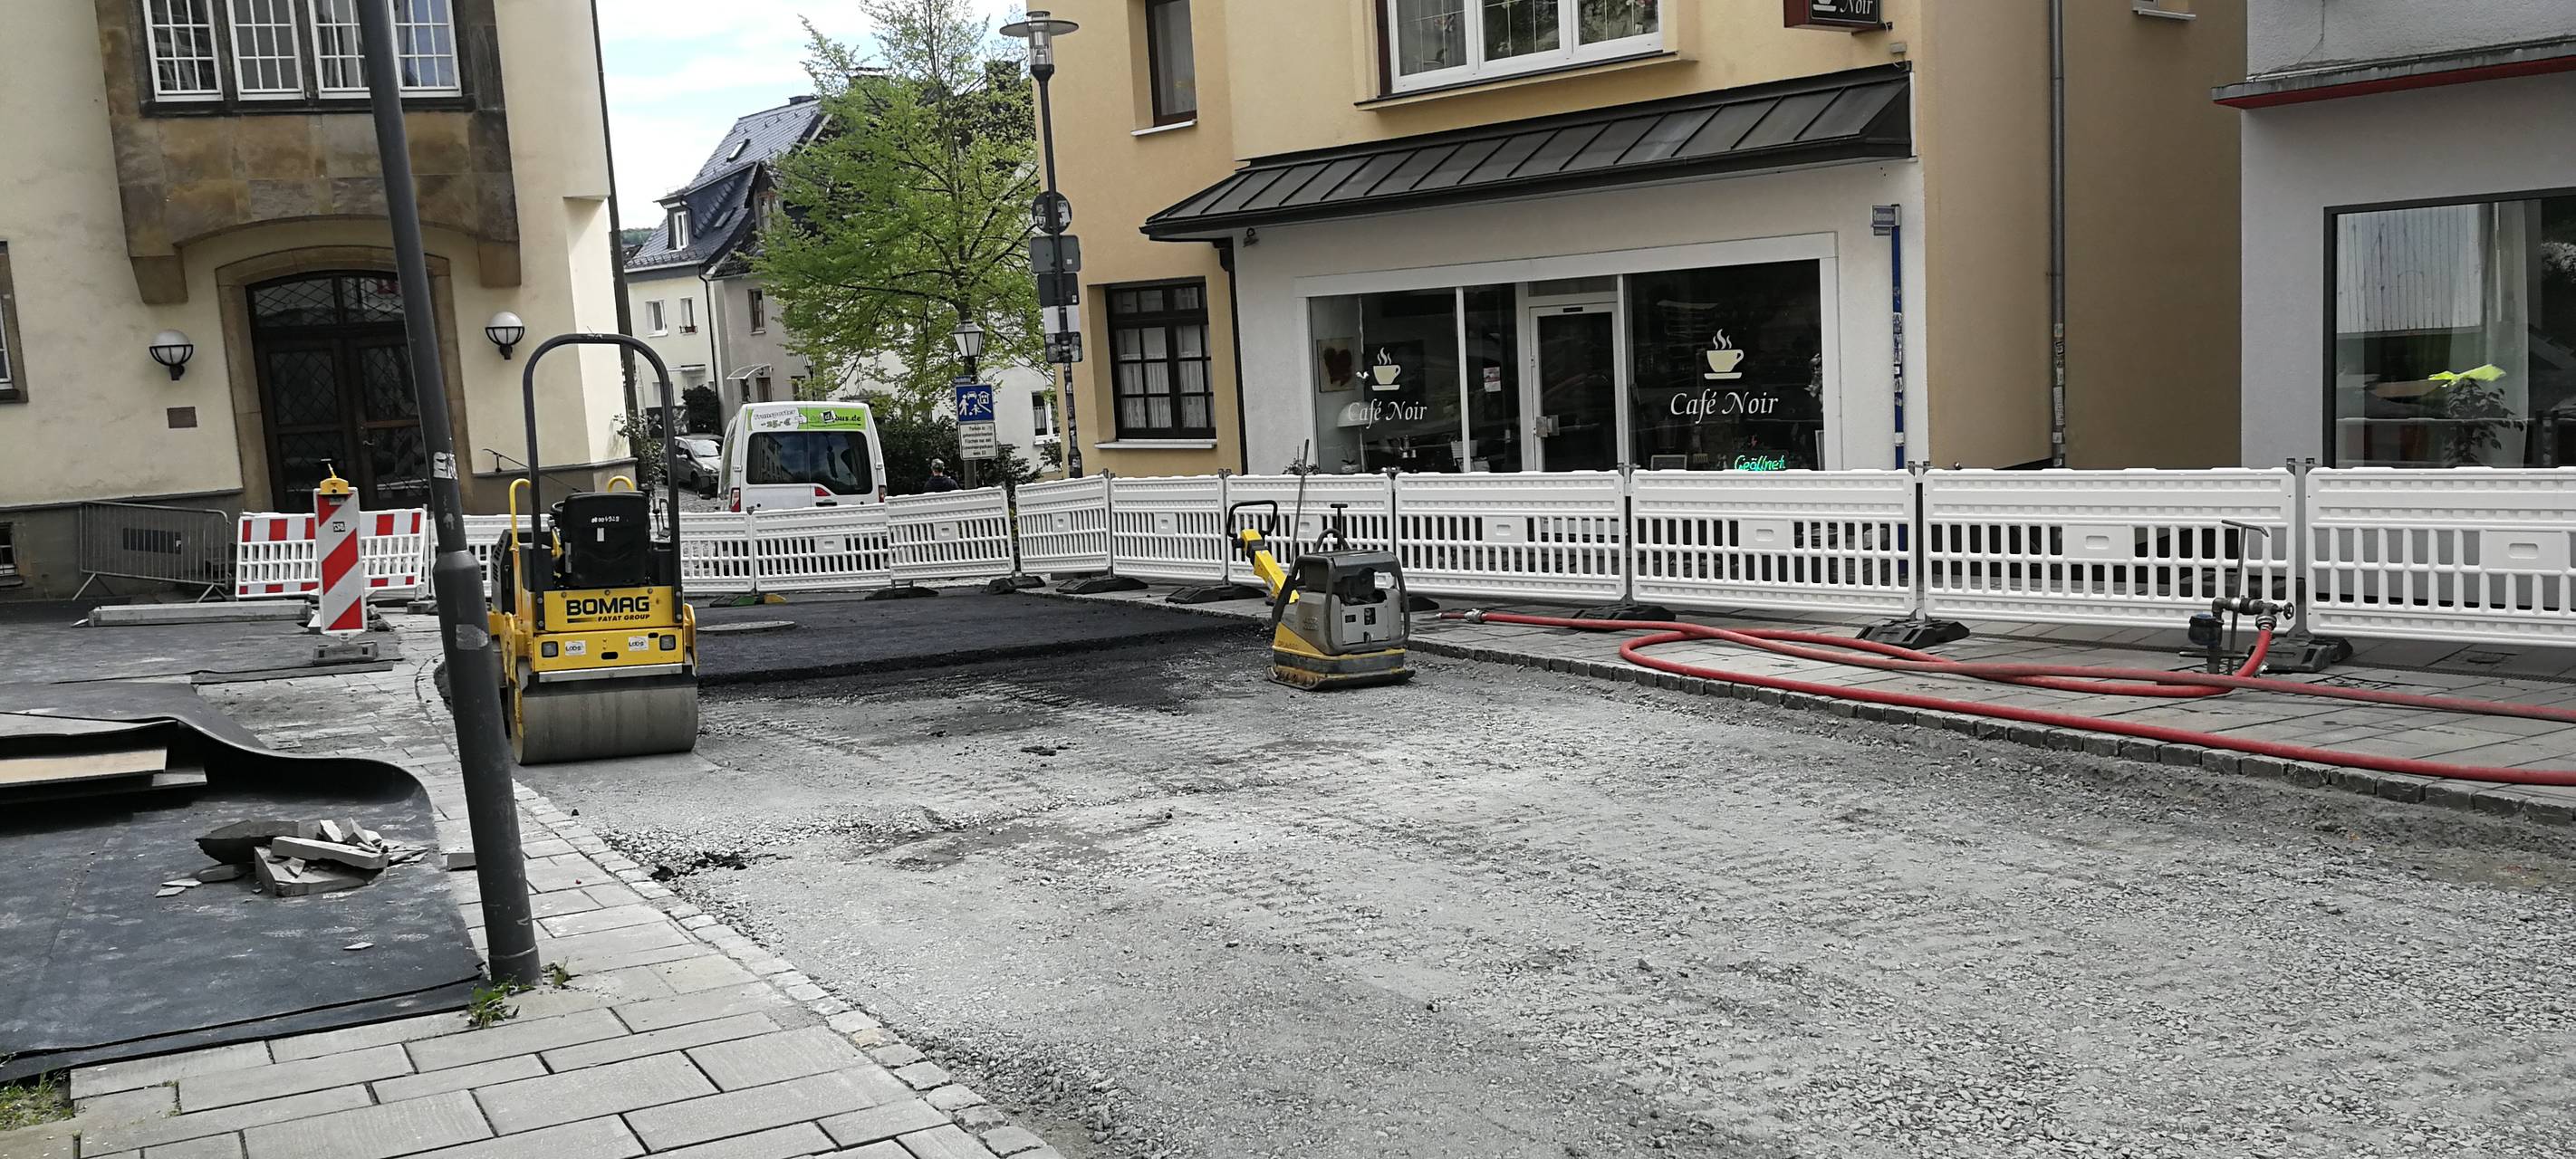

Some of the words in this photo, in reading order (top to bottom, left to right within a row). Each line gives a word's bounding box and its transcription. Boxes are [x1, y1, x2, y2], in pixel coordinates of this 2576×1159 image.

[1840, 0, 1873, 14] Noir
[1348, 398, 1382, 429] Café
[1385, 400, 1427, 421] Noir
[1670, 388, 1717, 425] Café
[1721, 391, 1779, 415] Noir
[566, 596, 650, 616] BOMAG
